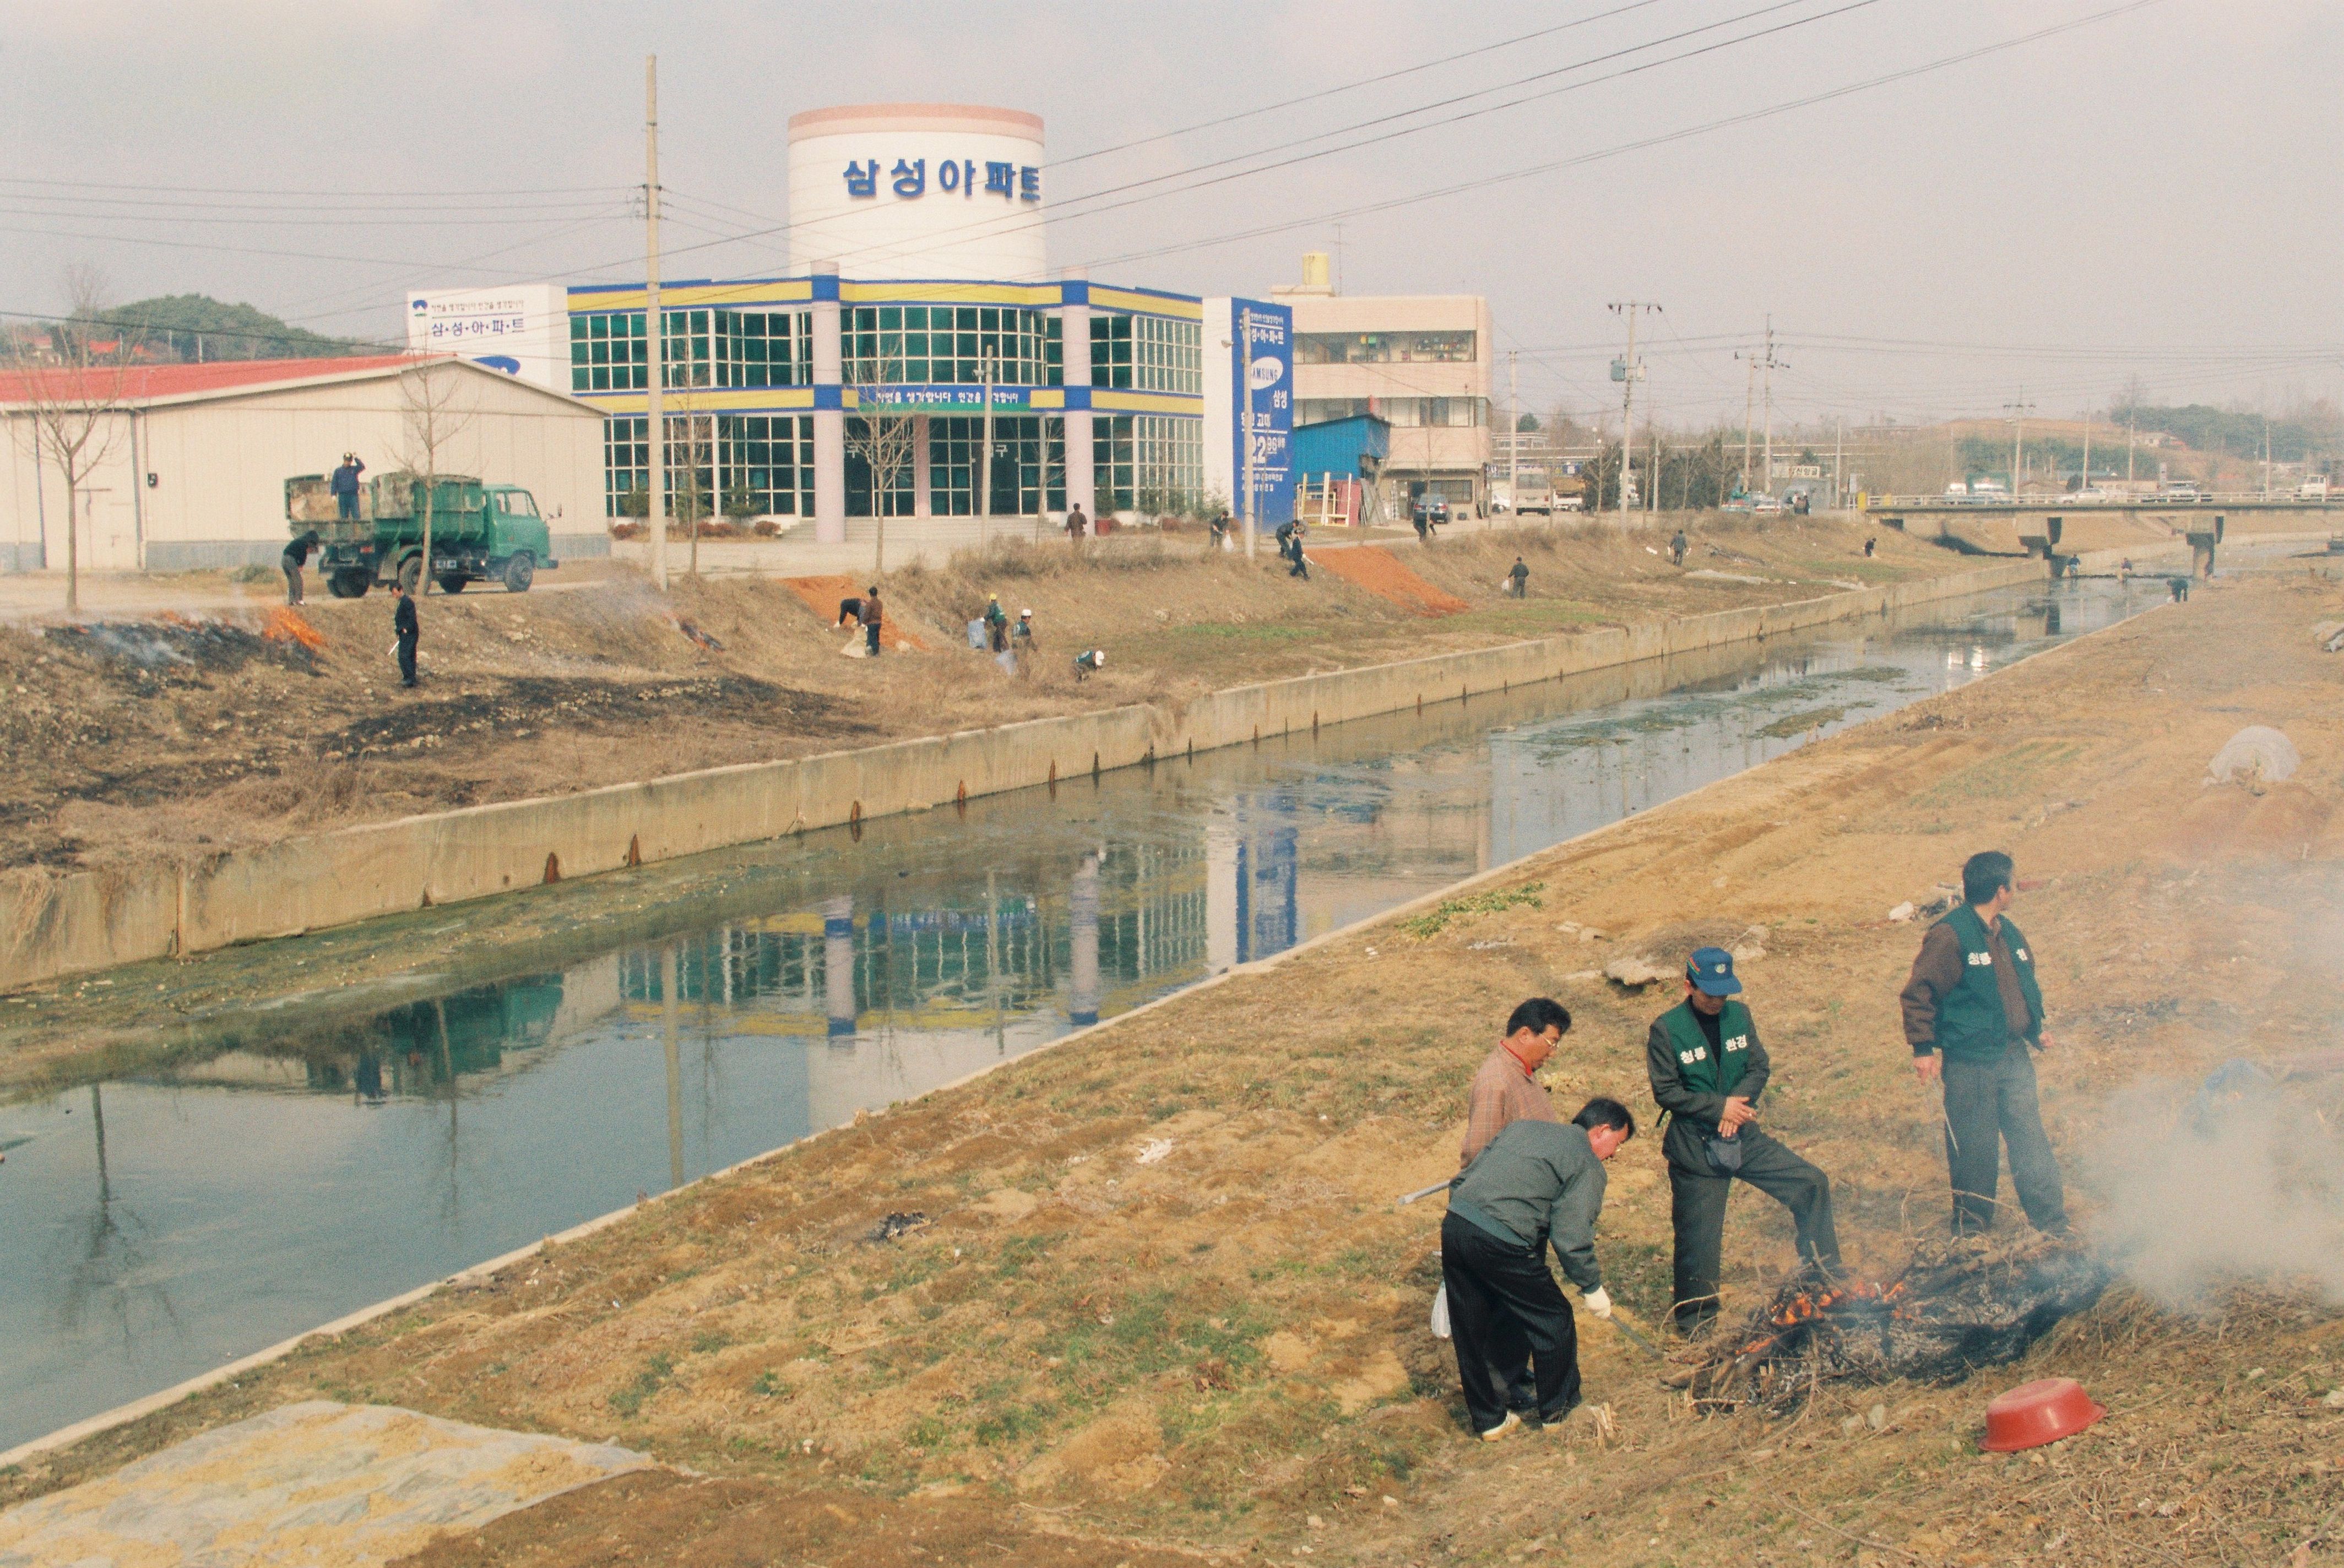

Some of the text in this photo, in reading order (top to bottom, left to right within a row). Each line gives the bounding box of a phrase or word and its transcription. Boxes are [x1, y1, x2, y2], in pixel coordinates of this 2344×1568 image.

[843, 159, 1040, 201] 삼성아파트
[1252, 367, 1278, 381] AMSUNG
[876, 392, 1018, 404] 자연을 생각합니다 인간을 각합니다
[1273, 390, 1288, 409] 삼성
